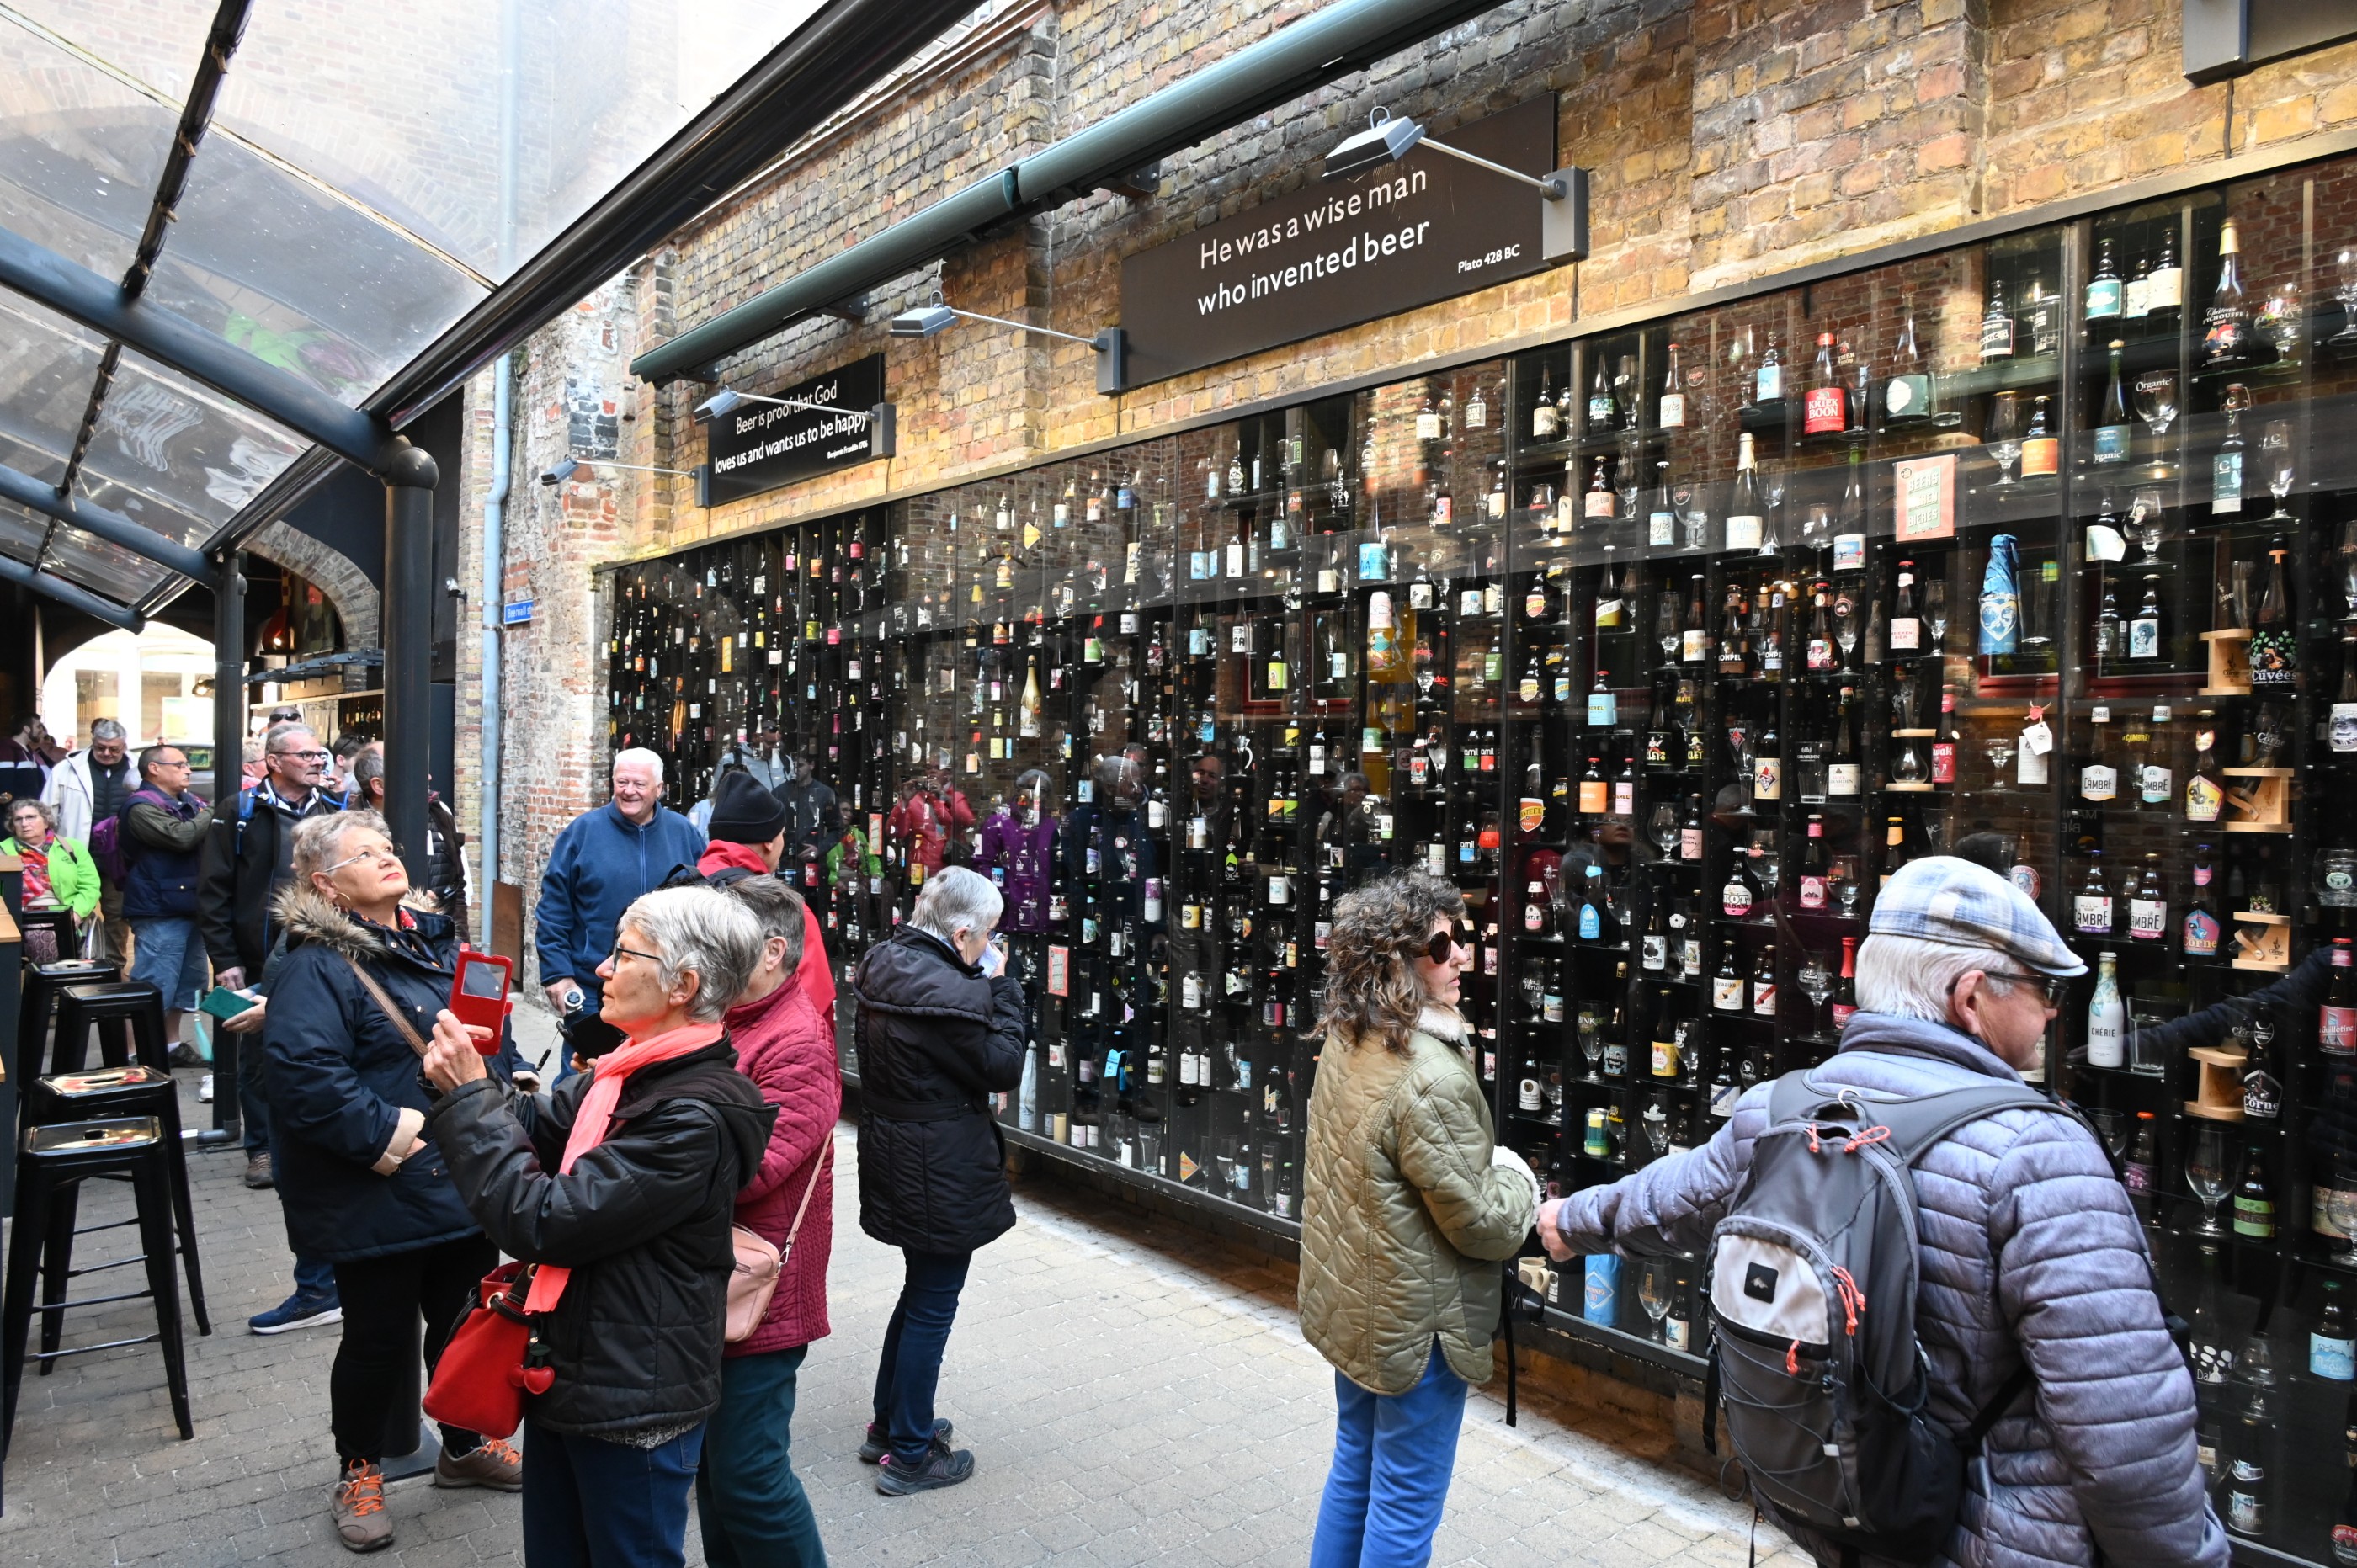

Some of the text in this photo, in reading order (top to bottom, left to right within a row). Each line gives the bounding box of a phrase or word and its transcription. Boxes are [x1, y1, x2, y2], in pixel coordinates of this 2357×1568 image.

[1200, 169, 1427, 269] He was a wise man
[1457, 243, 1521, 274] Plato 428 BC
[1197, 220, 1430, 316] who invented beer
[736, 380, 838, 435] Beer is proof that God
[1808, 399, 1838, 409] KRIEK
[1808, 407, 1838, 418] BOON
[715, 413, 866, 475] loves us and wants us to be happy
[2252, 668, 2298, 683] Cuvées
[2084, 777, 2113, 791] CAMBRE
[1658, 938, 1665, 946] 10
[2091, 1026, 2115, 1038] CHÉRIE
